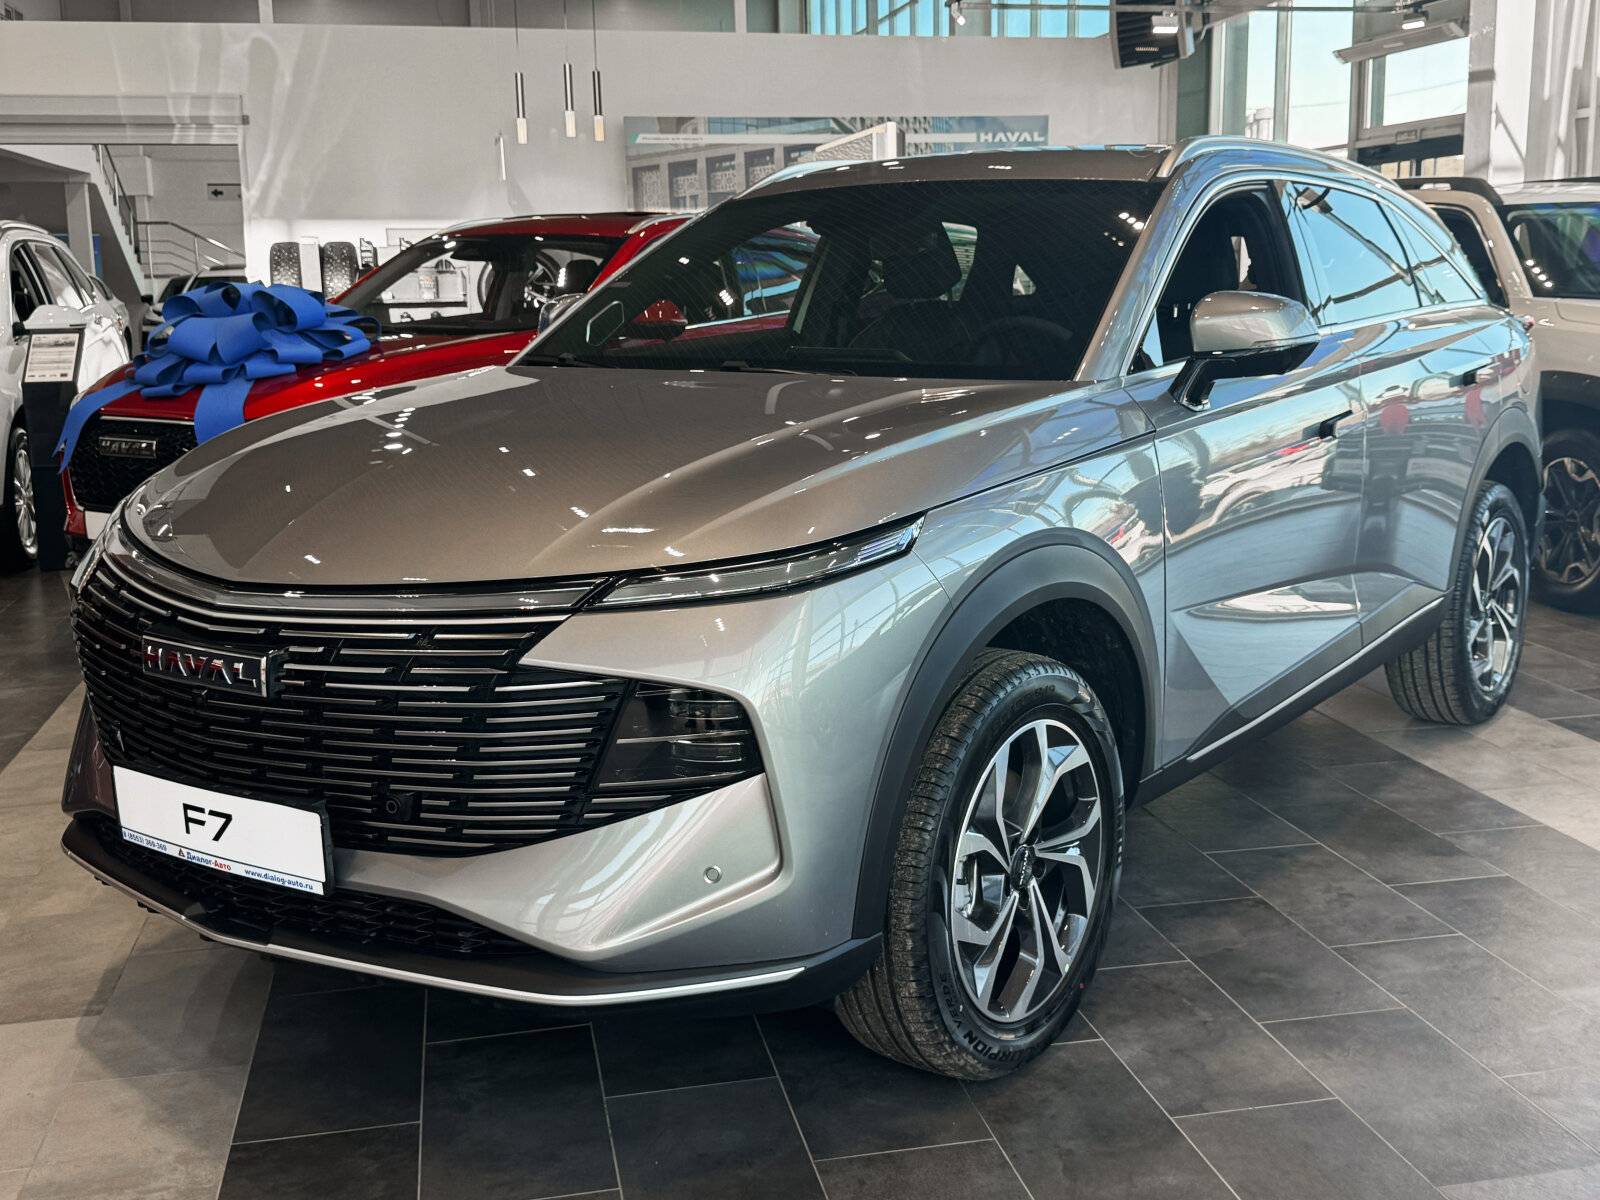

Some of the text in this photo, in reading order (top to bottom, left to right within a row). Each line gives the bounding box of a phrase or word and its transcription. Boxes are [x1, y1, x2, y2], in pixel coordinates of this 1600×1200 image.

[980, 131, 1045, 143] HAVAL
[144, 645, 257, 688] HAVAL
[182, 802, 233, 842] F7
[186, 851, 232, 871] Диалог-Авто
[244, 868, 314, 890] www.dialog-auto.ru
